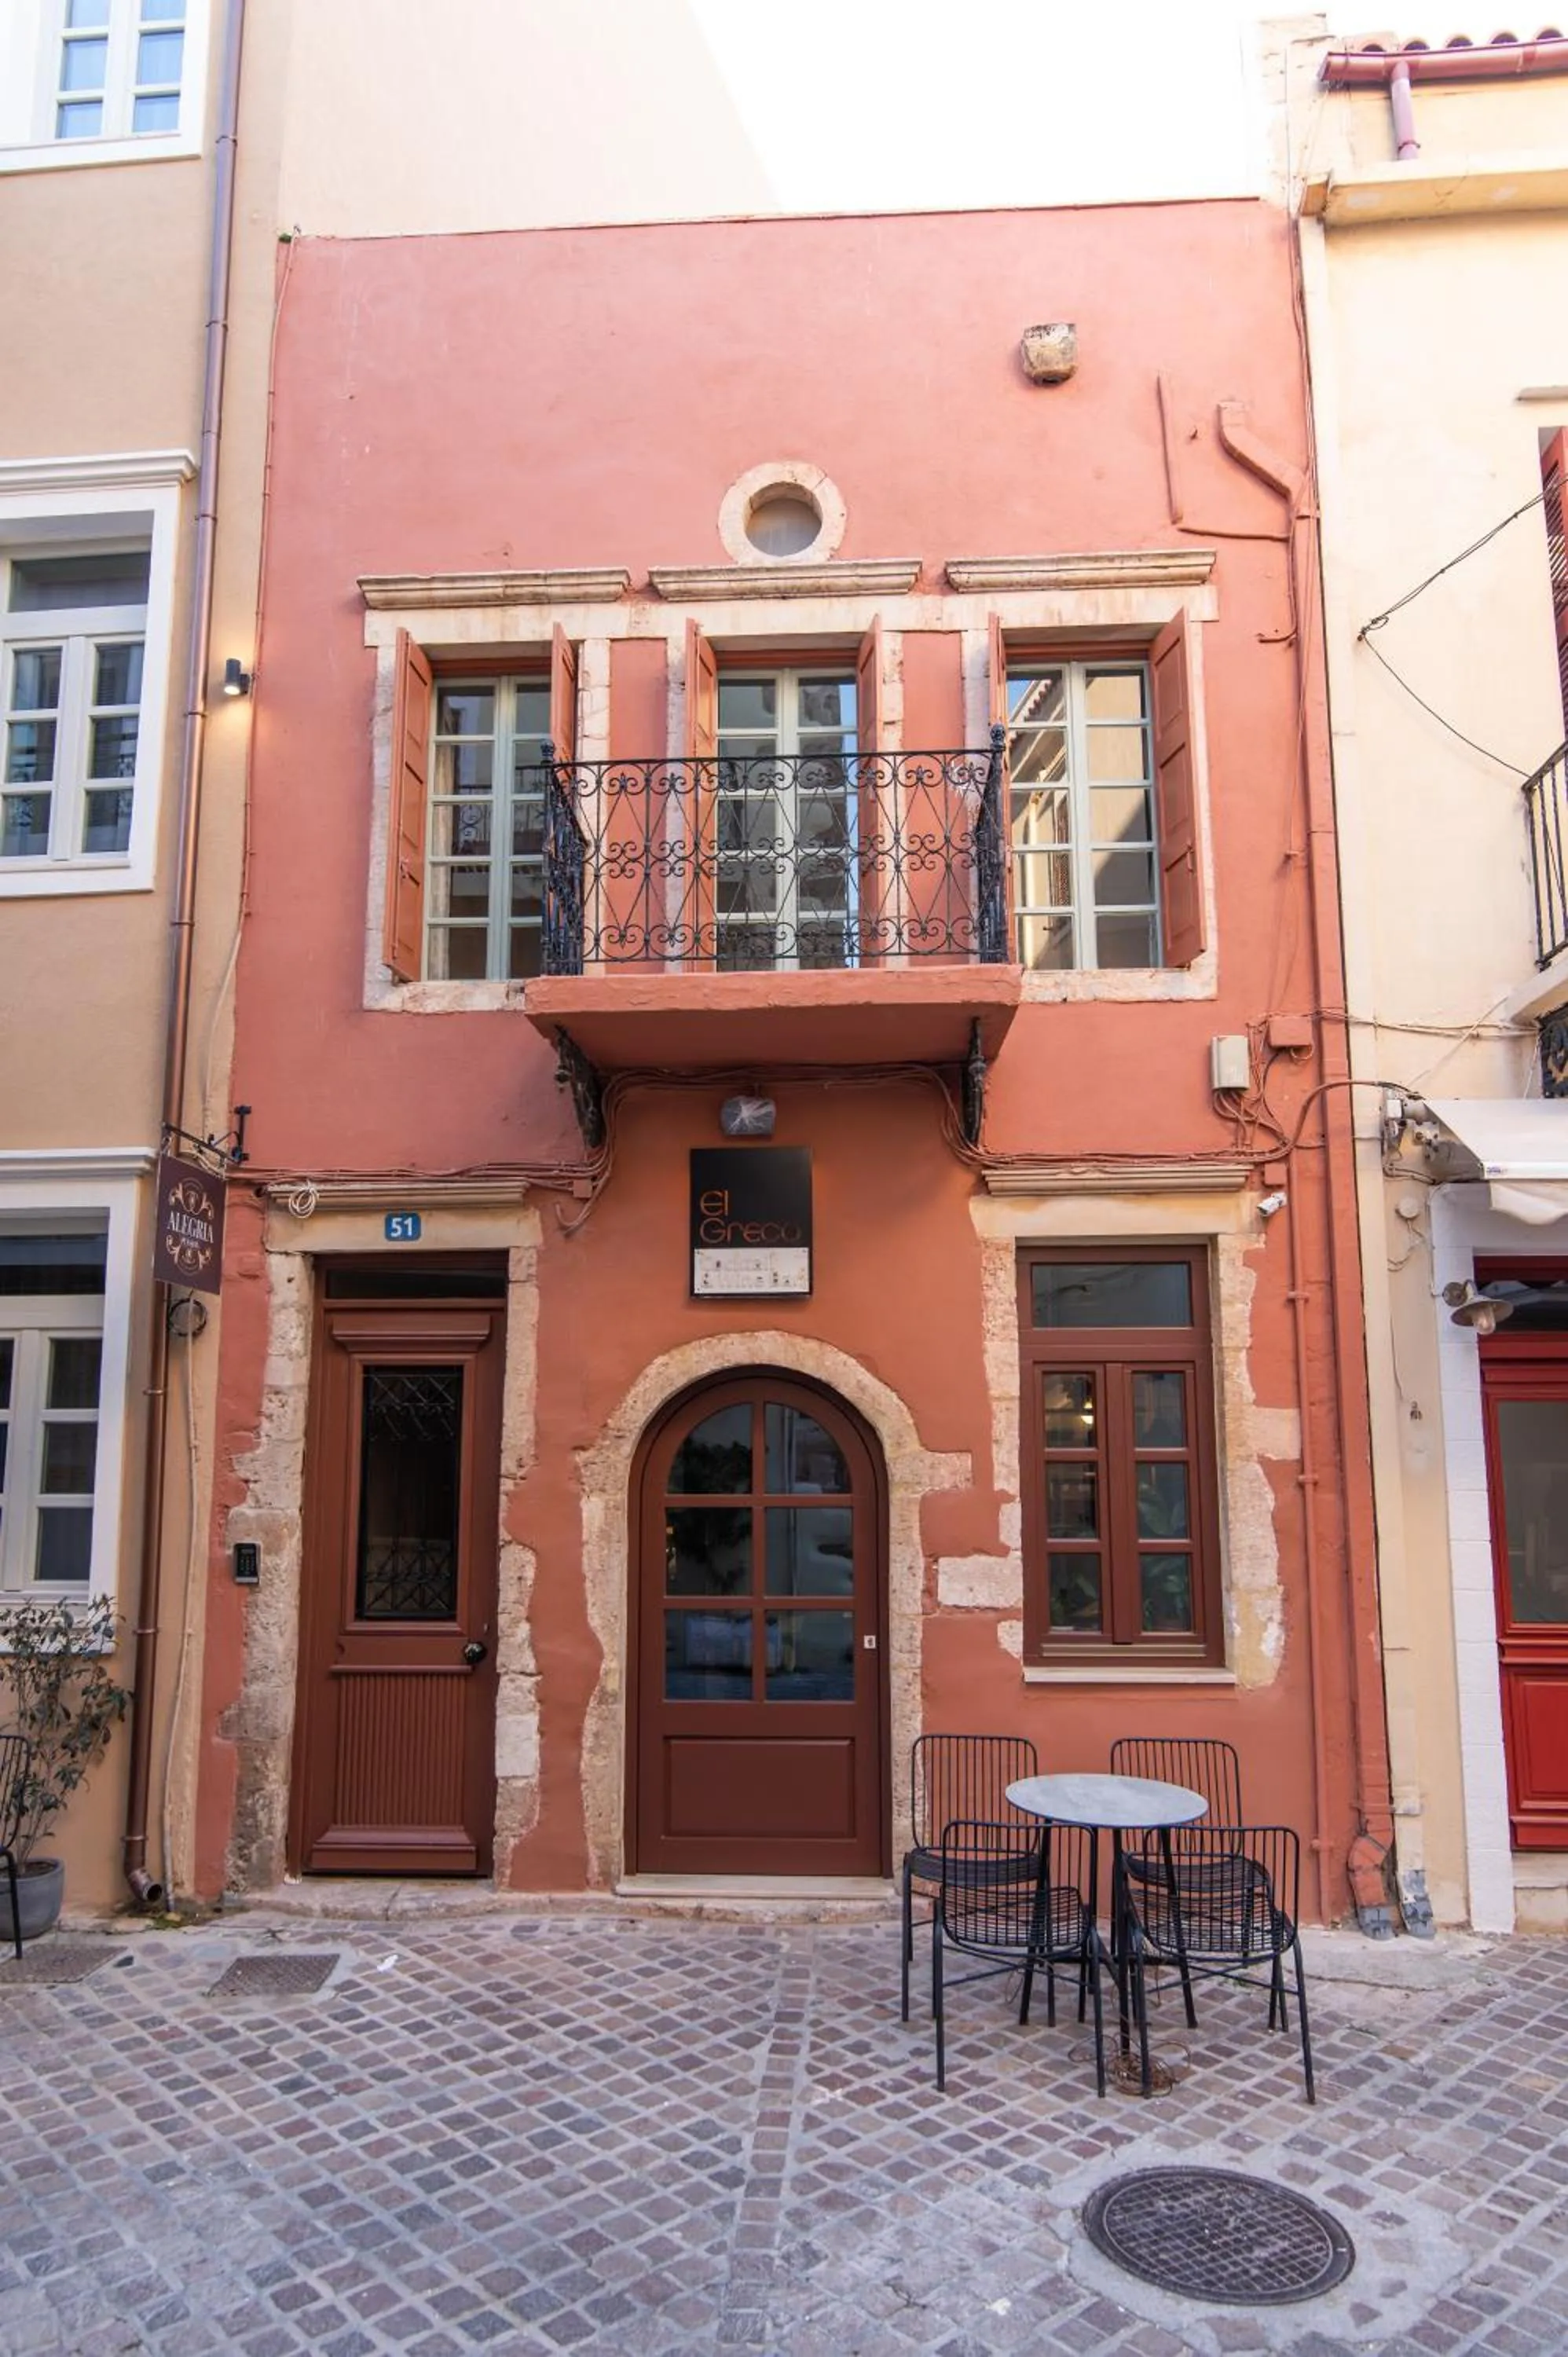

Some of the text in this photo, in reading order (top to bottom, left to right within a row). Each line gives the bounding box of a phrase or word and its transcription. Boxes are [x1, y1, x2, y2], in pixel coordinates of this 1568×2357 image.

[167, 1211, 214, 1244] ALEGRIA
[390, 1217, 413, 1238] 51
[699, 1217, 803, 1244] Greco
